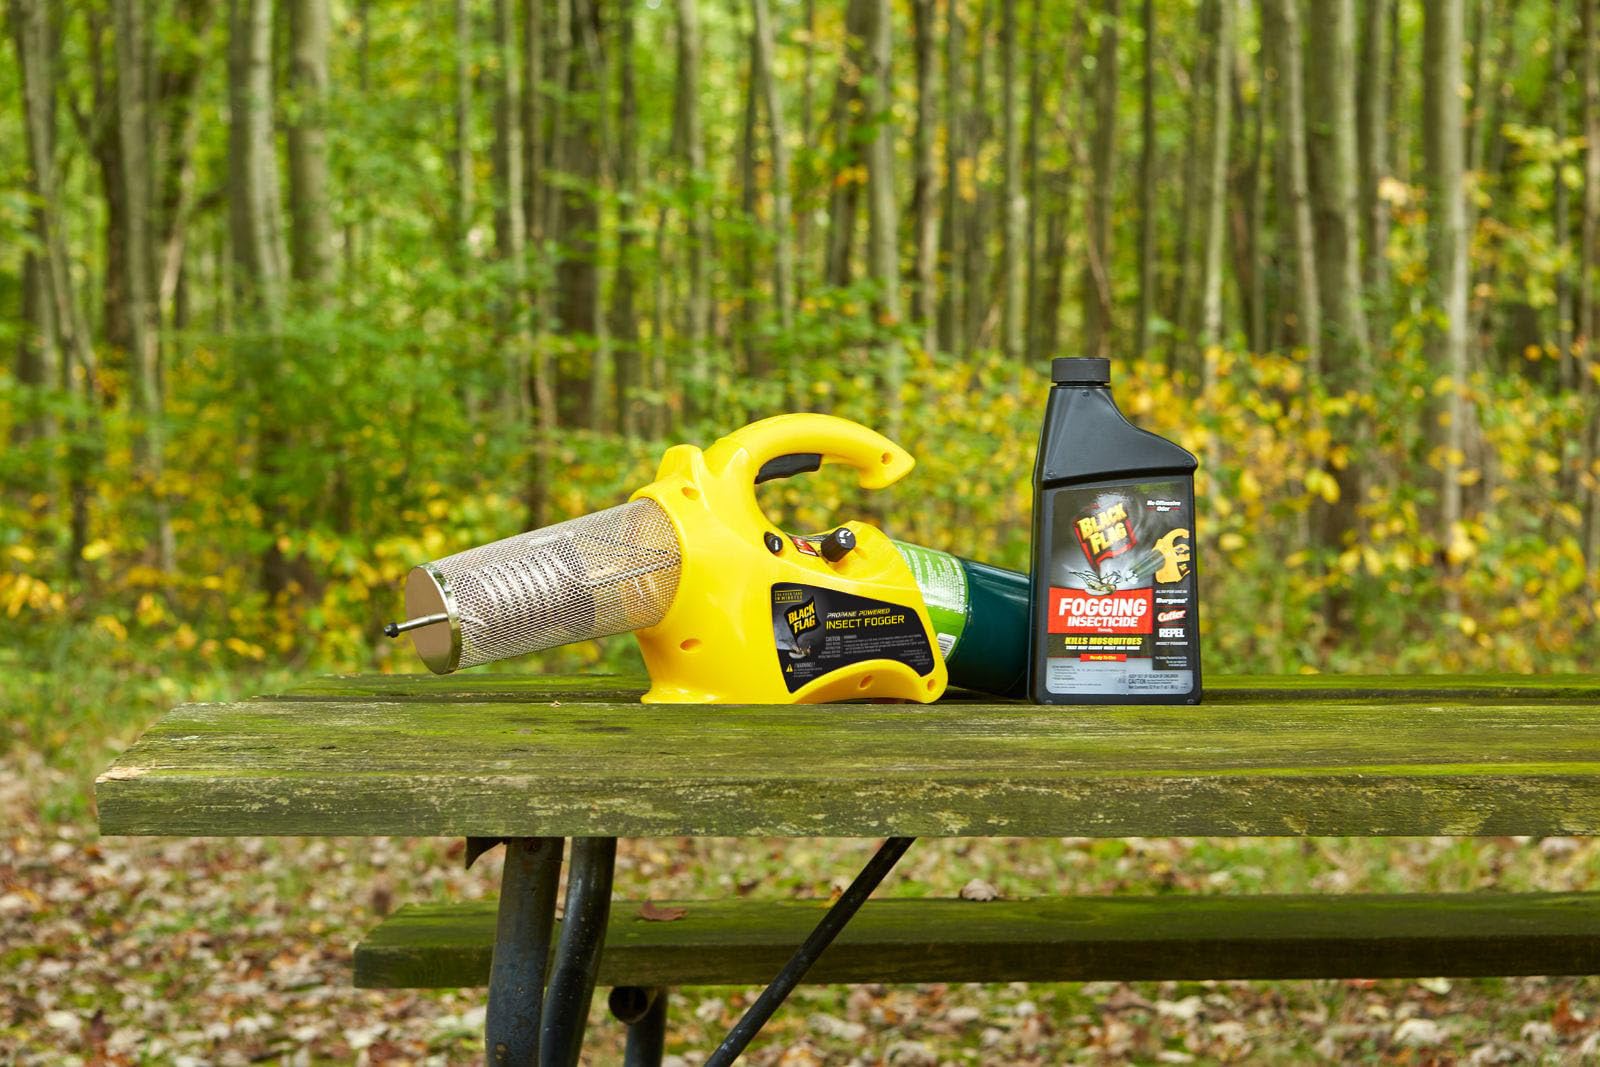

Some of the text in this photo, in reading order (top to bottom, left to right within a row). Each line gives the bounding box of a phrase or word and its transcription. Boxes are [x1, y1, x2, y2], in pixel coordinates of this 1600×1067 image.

[1077, 503, 1128, 540] BLACK
[1088, 522, 1128, 555] FLAG
[787, 601, 815, 624] BLACK
[858, 607, 891, 616] POWERED
[1059, 598, 1147, 616] FOGGING
[793, 613, 816, 634] FLAG
[826, 615, 905, 630] INSECT FOGGER
[1067, 616, 1138, 627] INSECTICIDE
[1158, 628, 1186, 638] REPEL
[1064, 637, 1143, 646] KILLS MOSQUITOES
